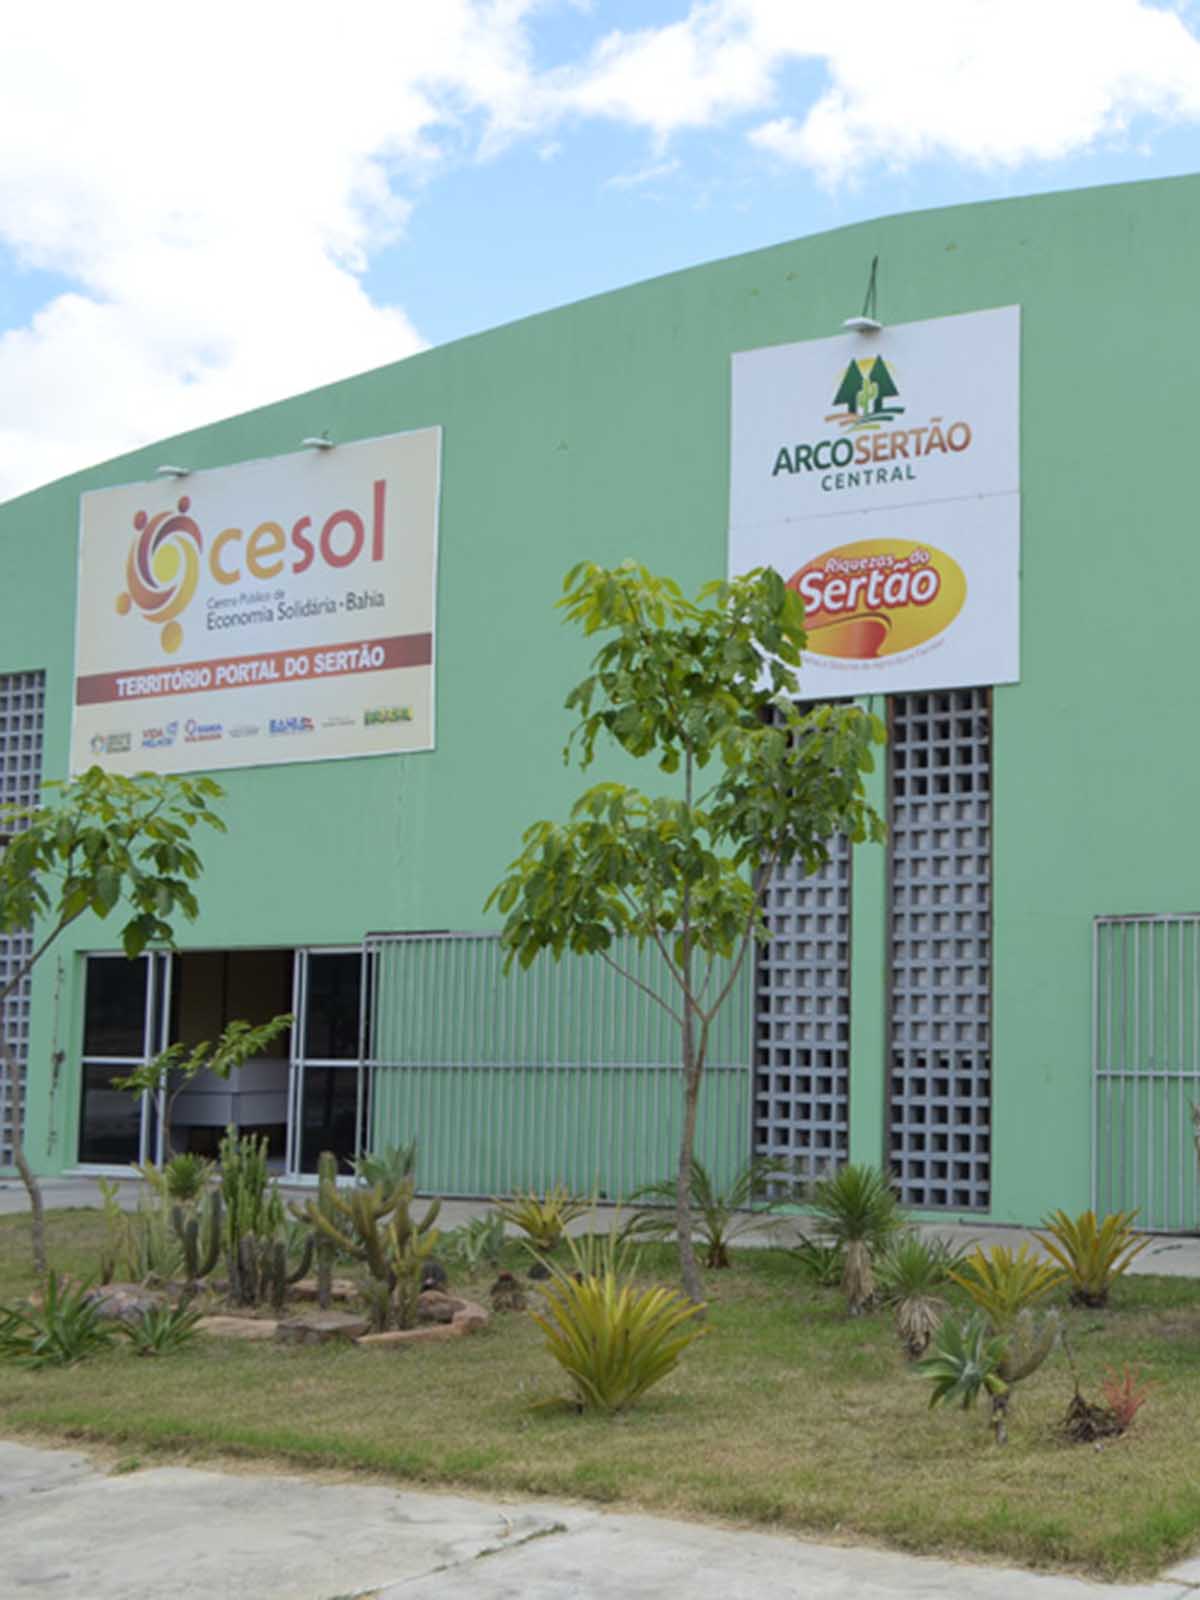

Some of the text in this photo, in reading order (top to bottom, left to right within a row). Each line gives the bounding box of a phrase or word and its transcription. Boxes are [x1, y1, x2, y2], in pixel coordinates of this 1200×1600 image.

[821, 463, 917, 492] CENTRAL
[207, 478, 387, 586] cesol
[824, 549, 930, 575] Riquezas do
[206, 590, 386, 631] Economia Solidária Bahia
[799, 560, 940, 614] Sertão
[116, 644, 386, 697] TERRITÓRIO PORTAL DO SERTÃO
